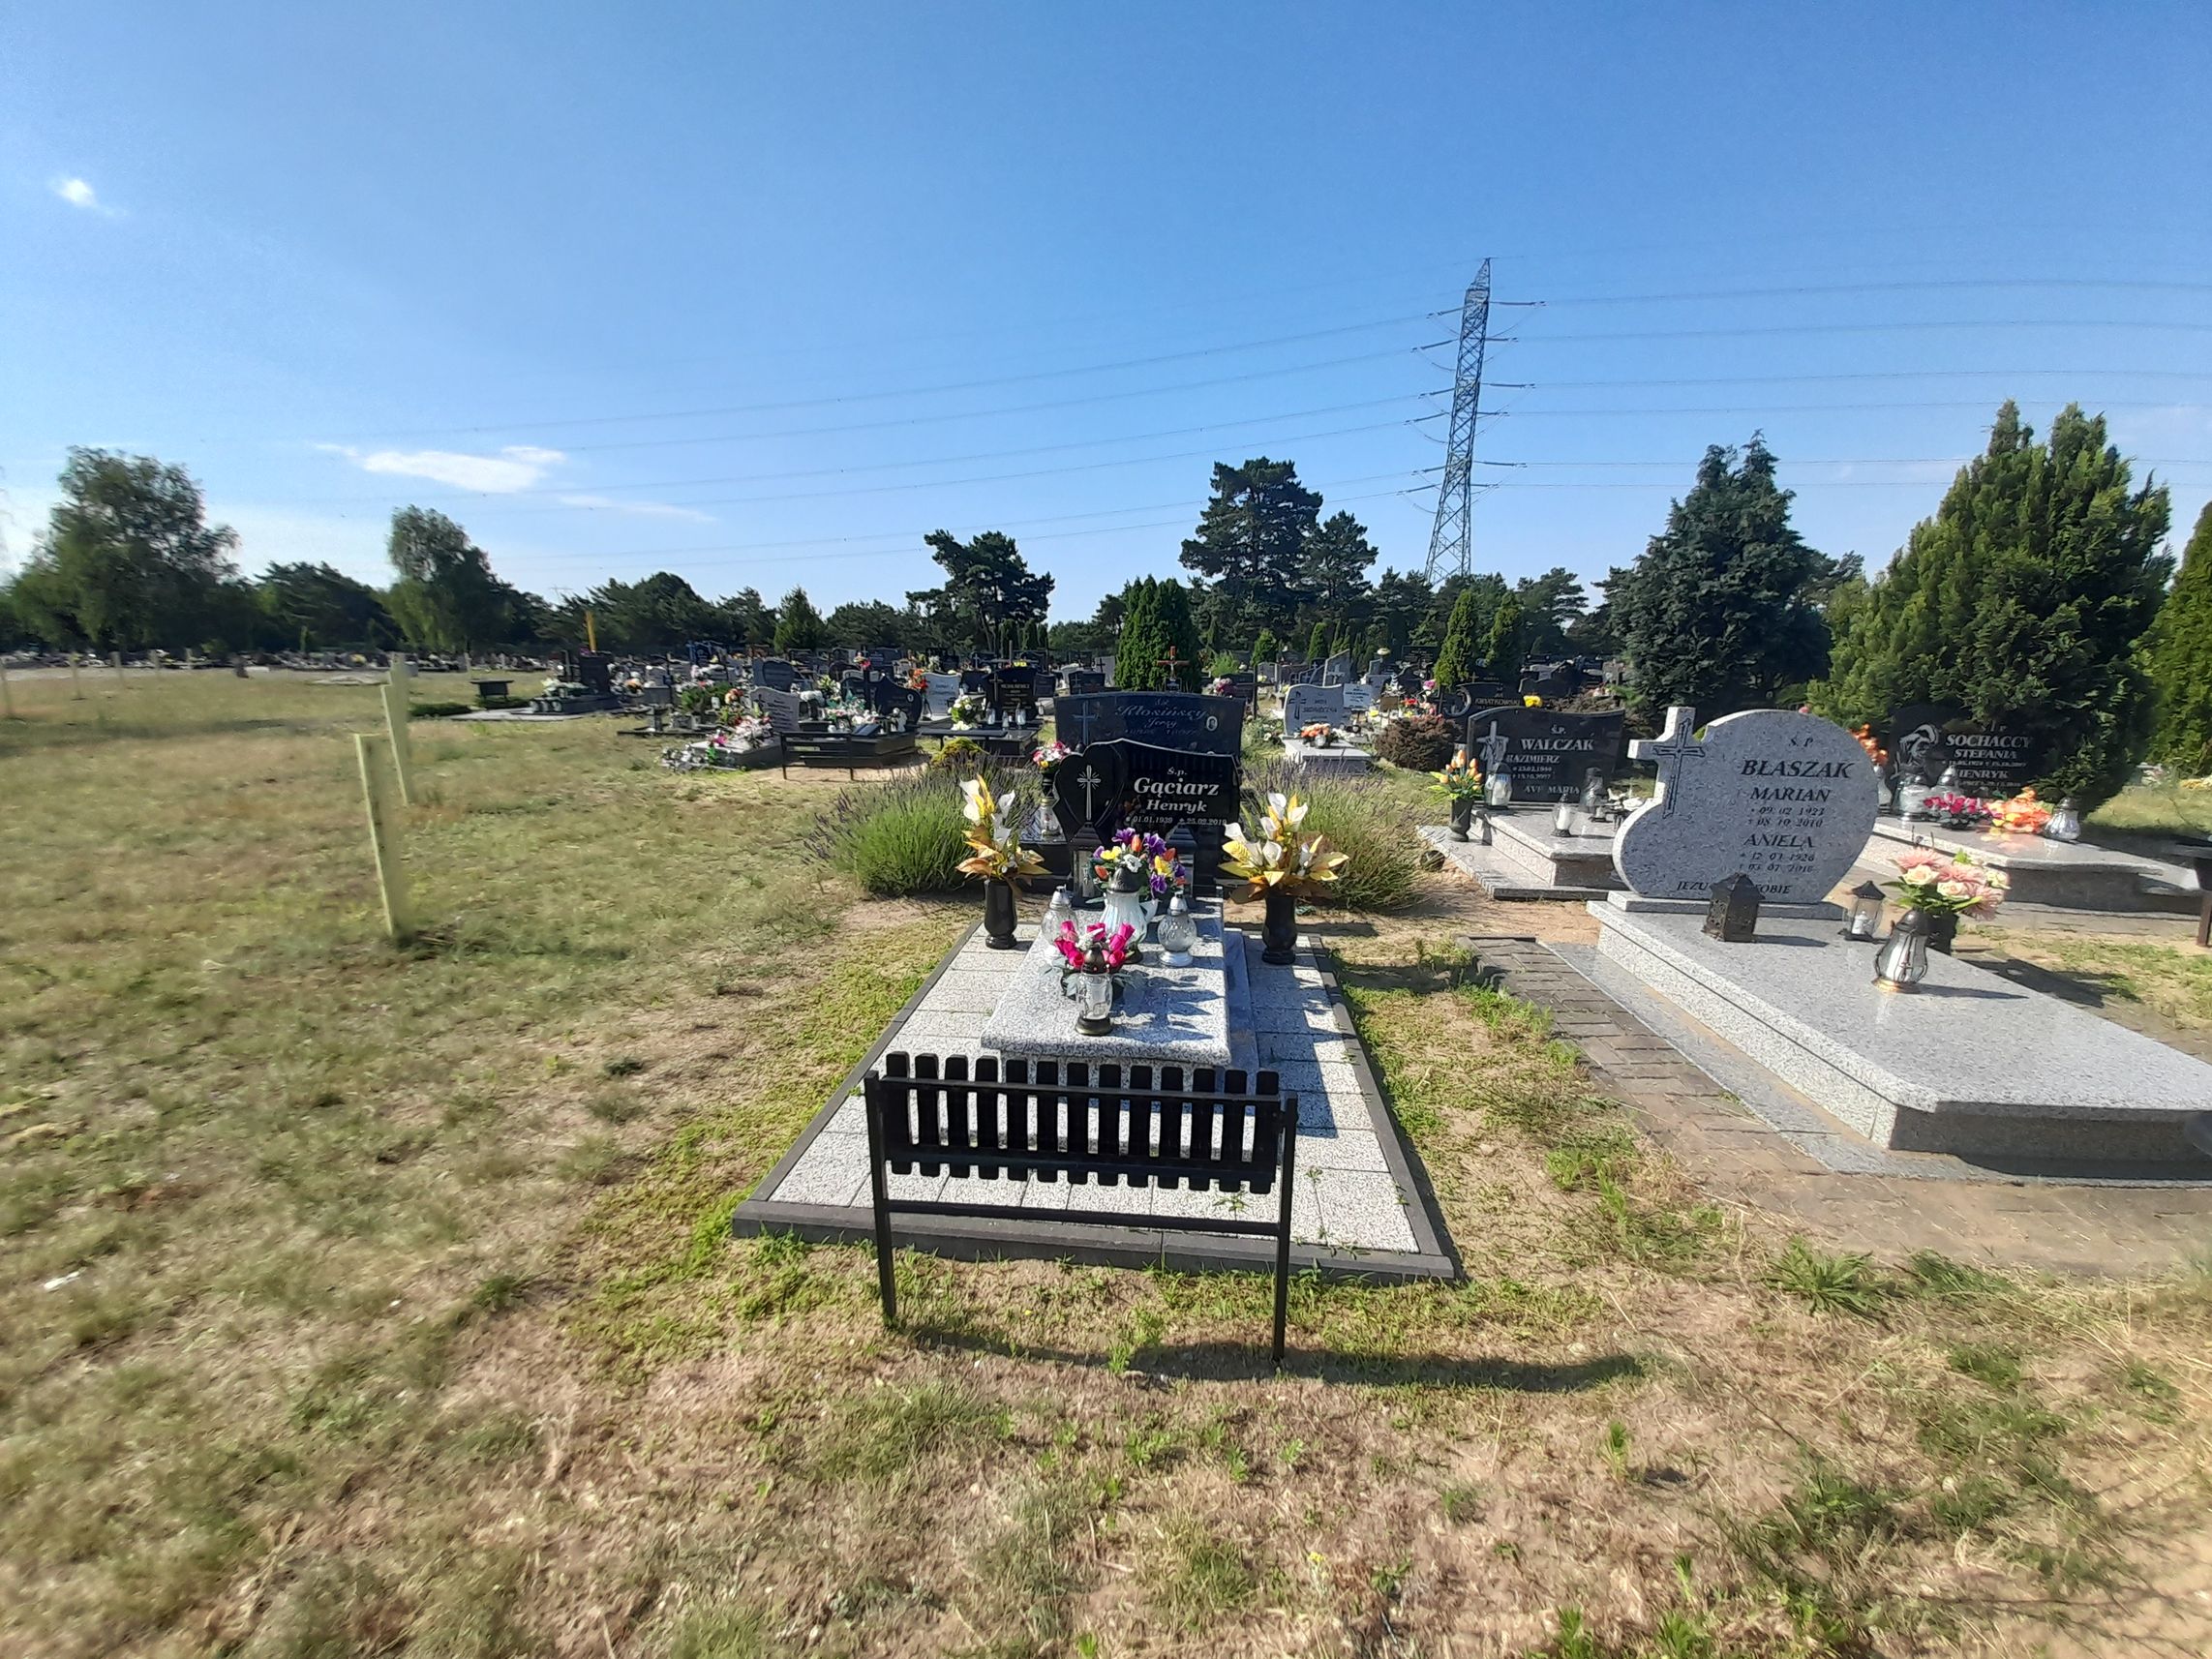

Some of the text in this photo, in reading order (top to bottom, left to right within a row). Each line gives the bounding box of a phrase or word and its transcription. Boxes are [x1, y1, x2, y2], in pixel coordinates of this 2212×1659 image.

[1521, 739, 1594, 751] WALCZAK
[1945, 734, 2031, 748] SOCHACCY
[1505, 755, 1561, 764] KAZIMIERZ
[1954, 748, 2017, 759] STEFANIA
[1741, 759, 1856, 779] BŁASZAK
[1134, 776, 1220, 799] Gąciarz
[1749, 787, 1832, 802] MARIAN
[1146, 799, 1207, 815] Henryk
[1742, 833, 1815, 849] ANIELA
[1677, 881, 1711, 891] JEZU
